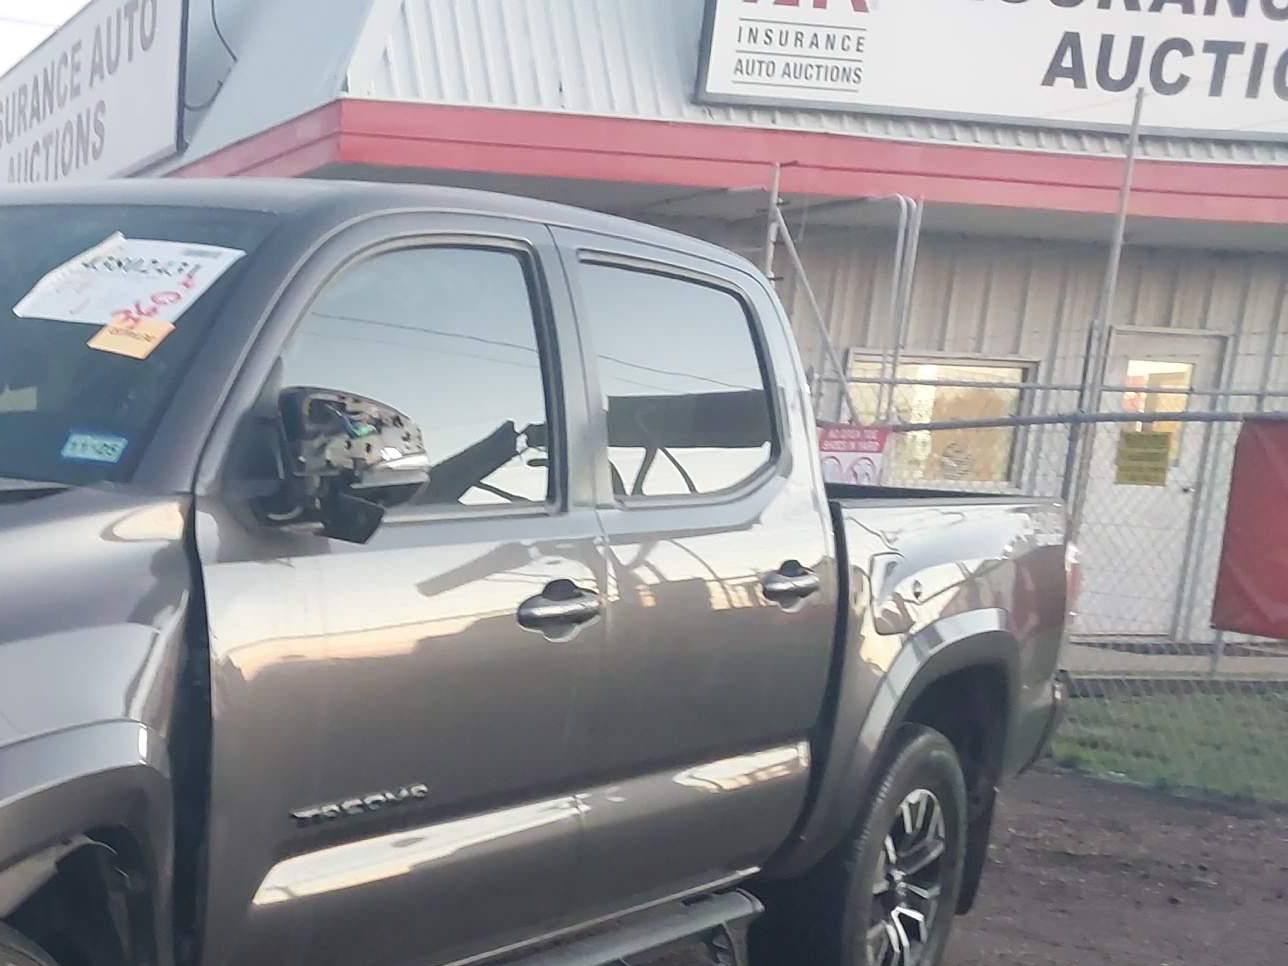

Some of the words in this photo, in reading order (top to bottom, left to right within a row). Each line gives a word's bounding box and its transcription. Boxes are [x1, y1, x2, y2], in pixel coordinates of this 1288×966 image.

[89, 0, 157, 89] AUTO
[737, 26, 865, 53] INSURANCE
[734, 58, 776, 78] AUTO
[781, 62, 863, 84] AUCTIONS
